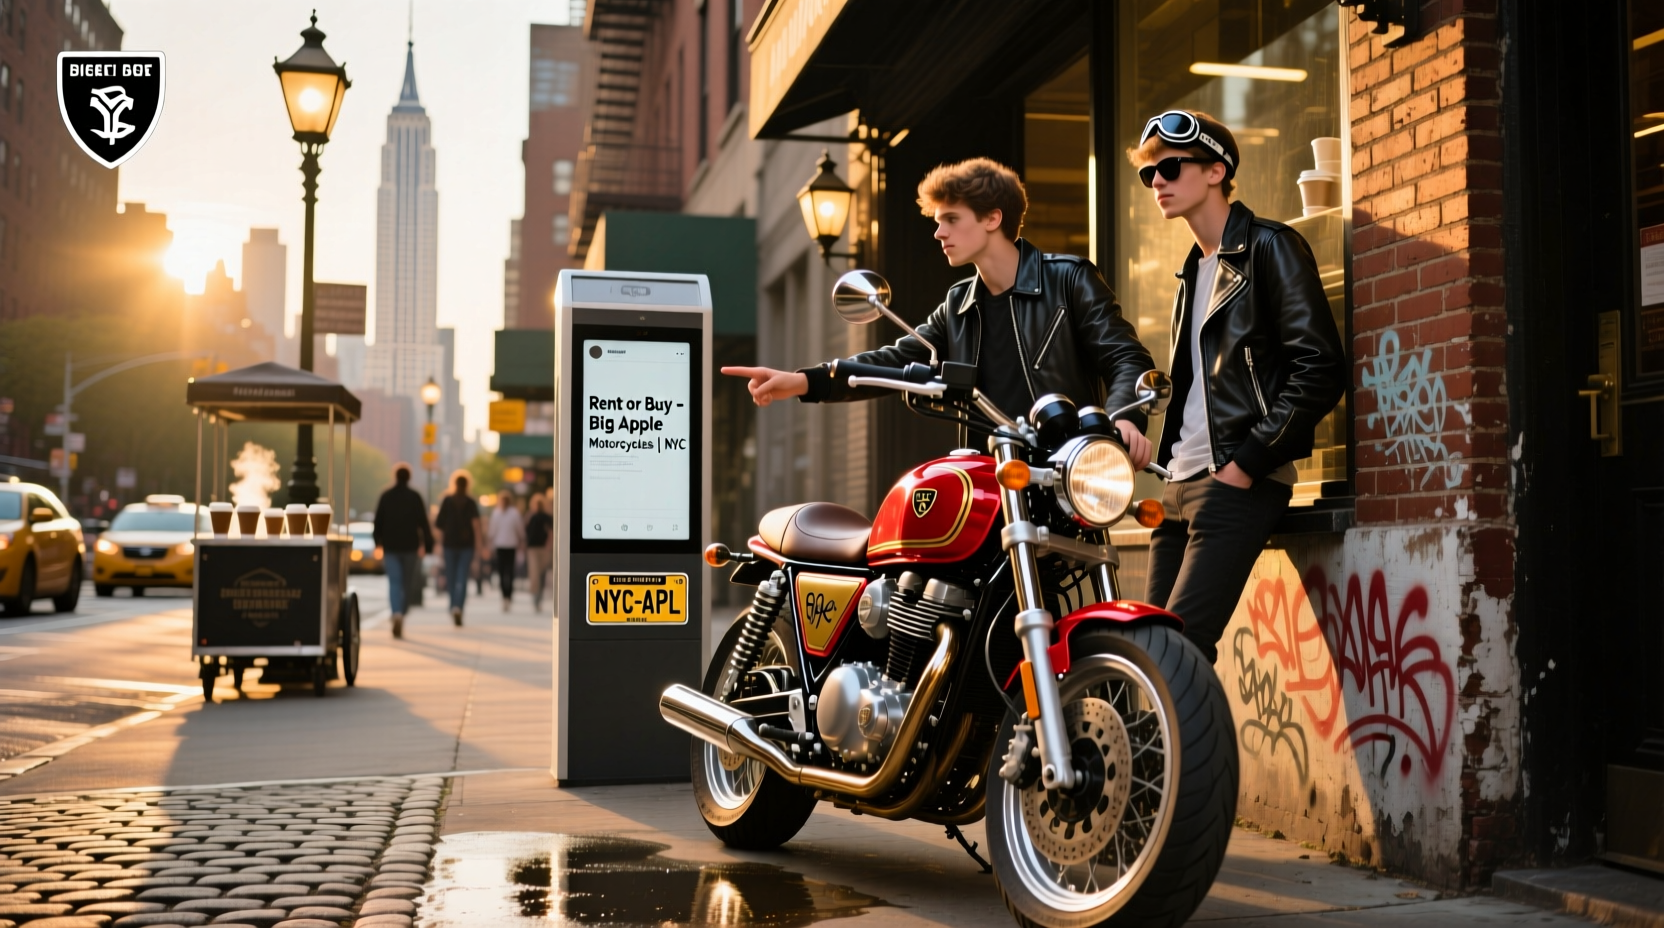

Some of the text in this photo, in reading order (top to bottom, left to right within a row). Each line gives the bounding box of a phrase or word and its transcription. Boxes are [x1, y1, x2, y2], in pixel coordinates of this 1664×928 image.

[589, 395, 623, 411] Rent
[626, 399, 642, 411] or
[645, 396, 673, 415] Buy
[589, 415, 663, 435] Big Apple
[589, 437, 654, 453] Motorcycles
[664, 437, 687, 450] NYC
[595, 589, 681, 615] NYC-APL
